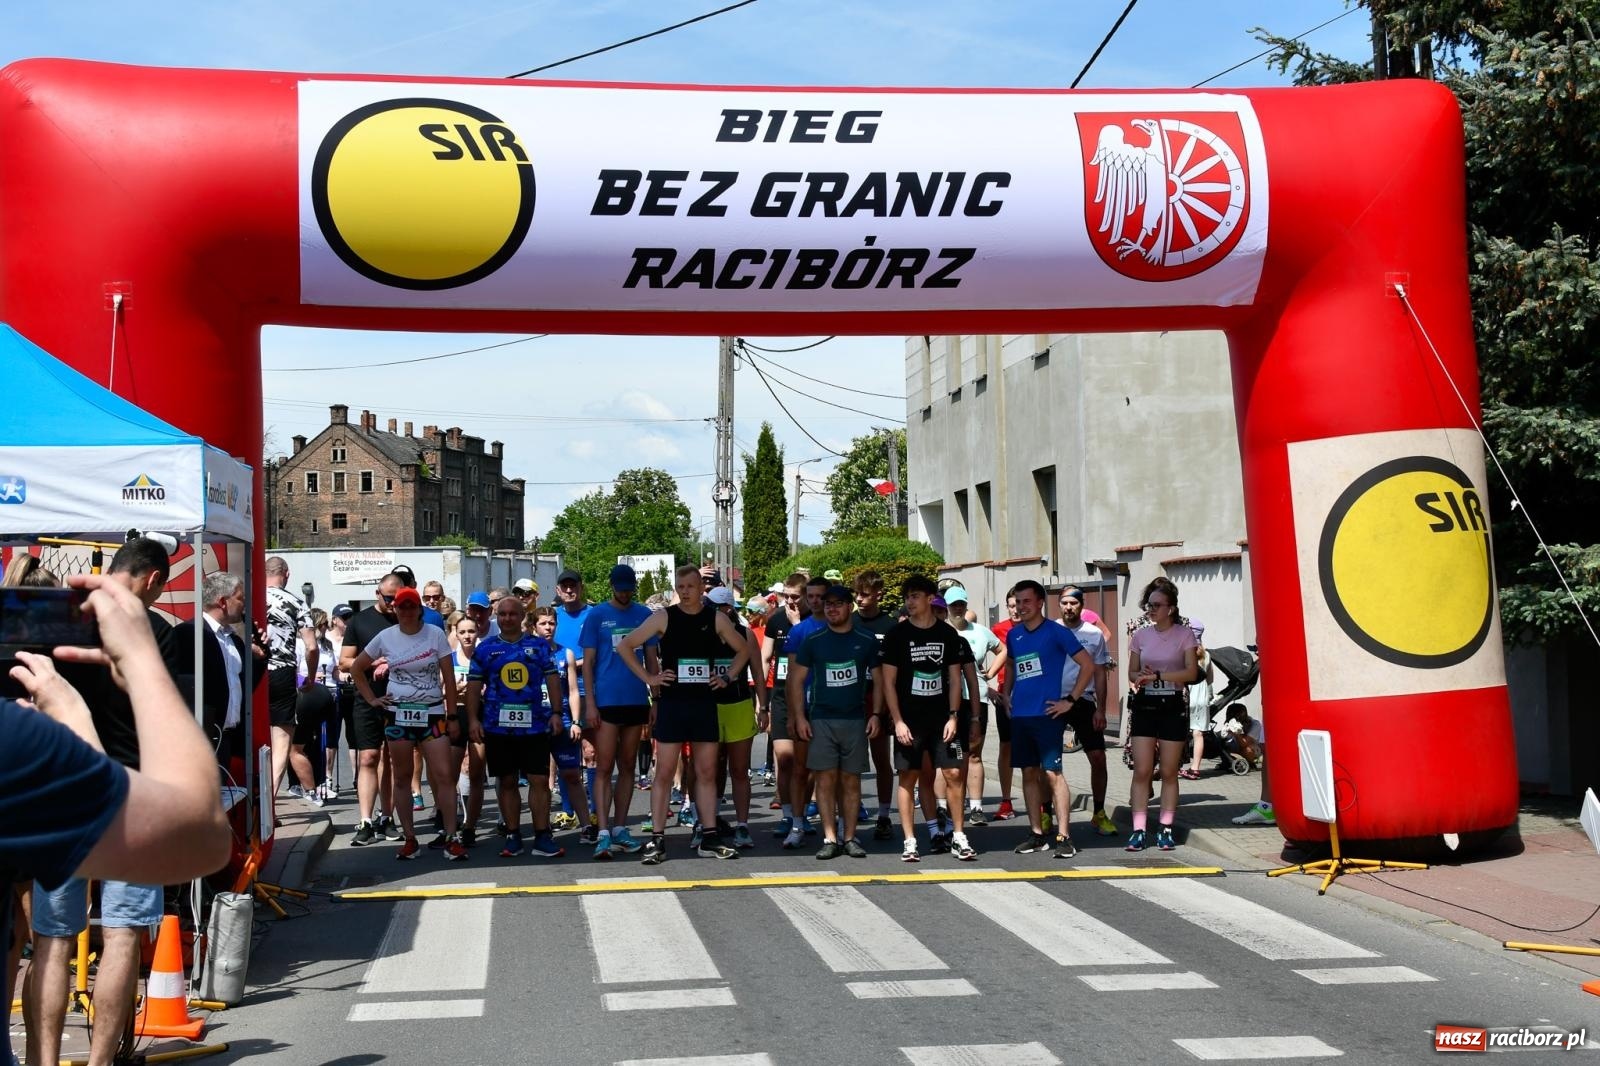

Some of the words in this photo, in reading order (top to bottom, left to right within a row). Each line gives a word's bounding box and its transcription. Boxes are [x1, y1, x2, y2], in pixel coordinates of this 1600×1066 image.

[716, 109, 882, 144] BIEG
[418, 123, 530, 162] SIR
[591, 170, 739, 217] BEZ
[750, 171, 1011, 218] GRANIC
[622, 235, 977, 290] RACIBÓRZ
[122, 487, 165, 500] MITKO
[1414, 488, 1488, 533] SIR
[688, 666, 703, 677] 95
[1018, 661, 1033, 673] 85
[832, 669, 852, 680] 100
[920, 680, 937, 690] 110
[1153, 679, 1165, 689] 81
[403, 711, 421, 721] 114
[508, 711, 524, 721] 83
